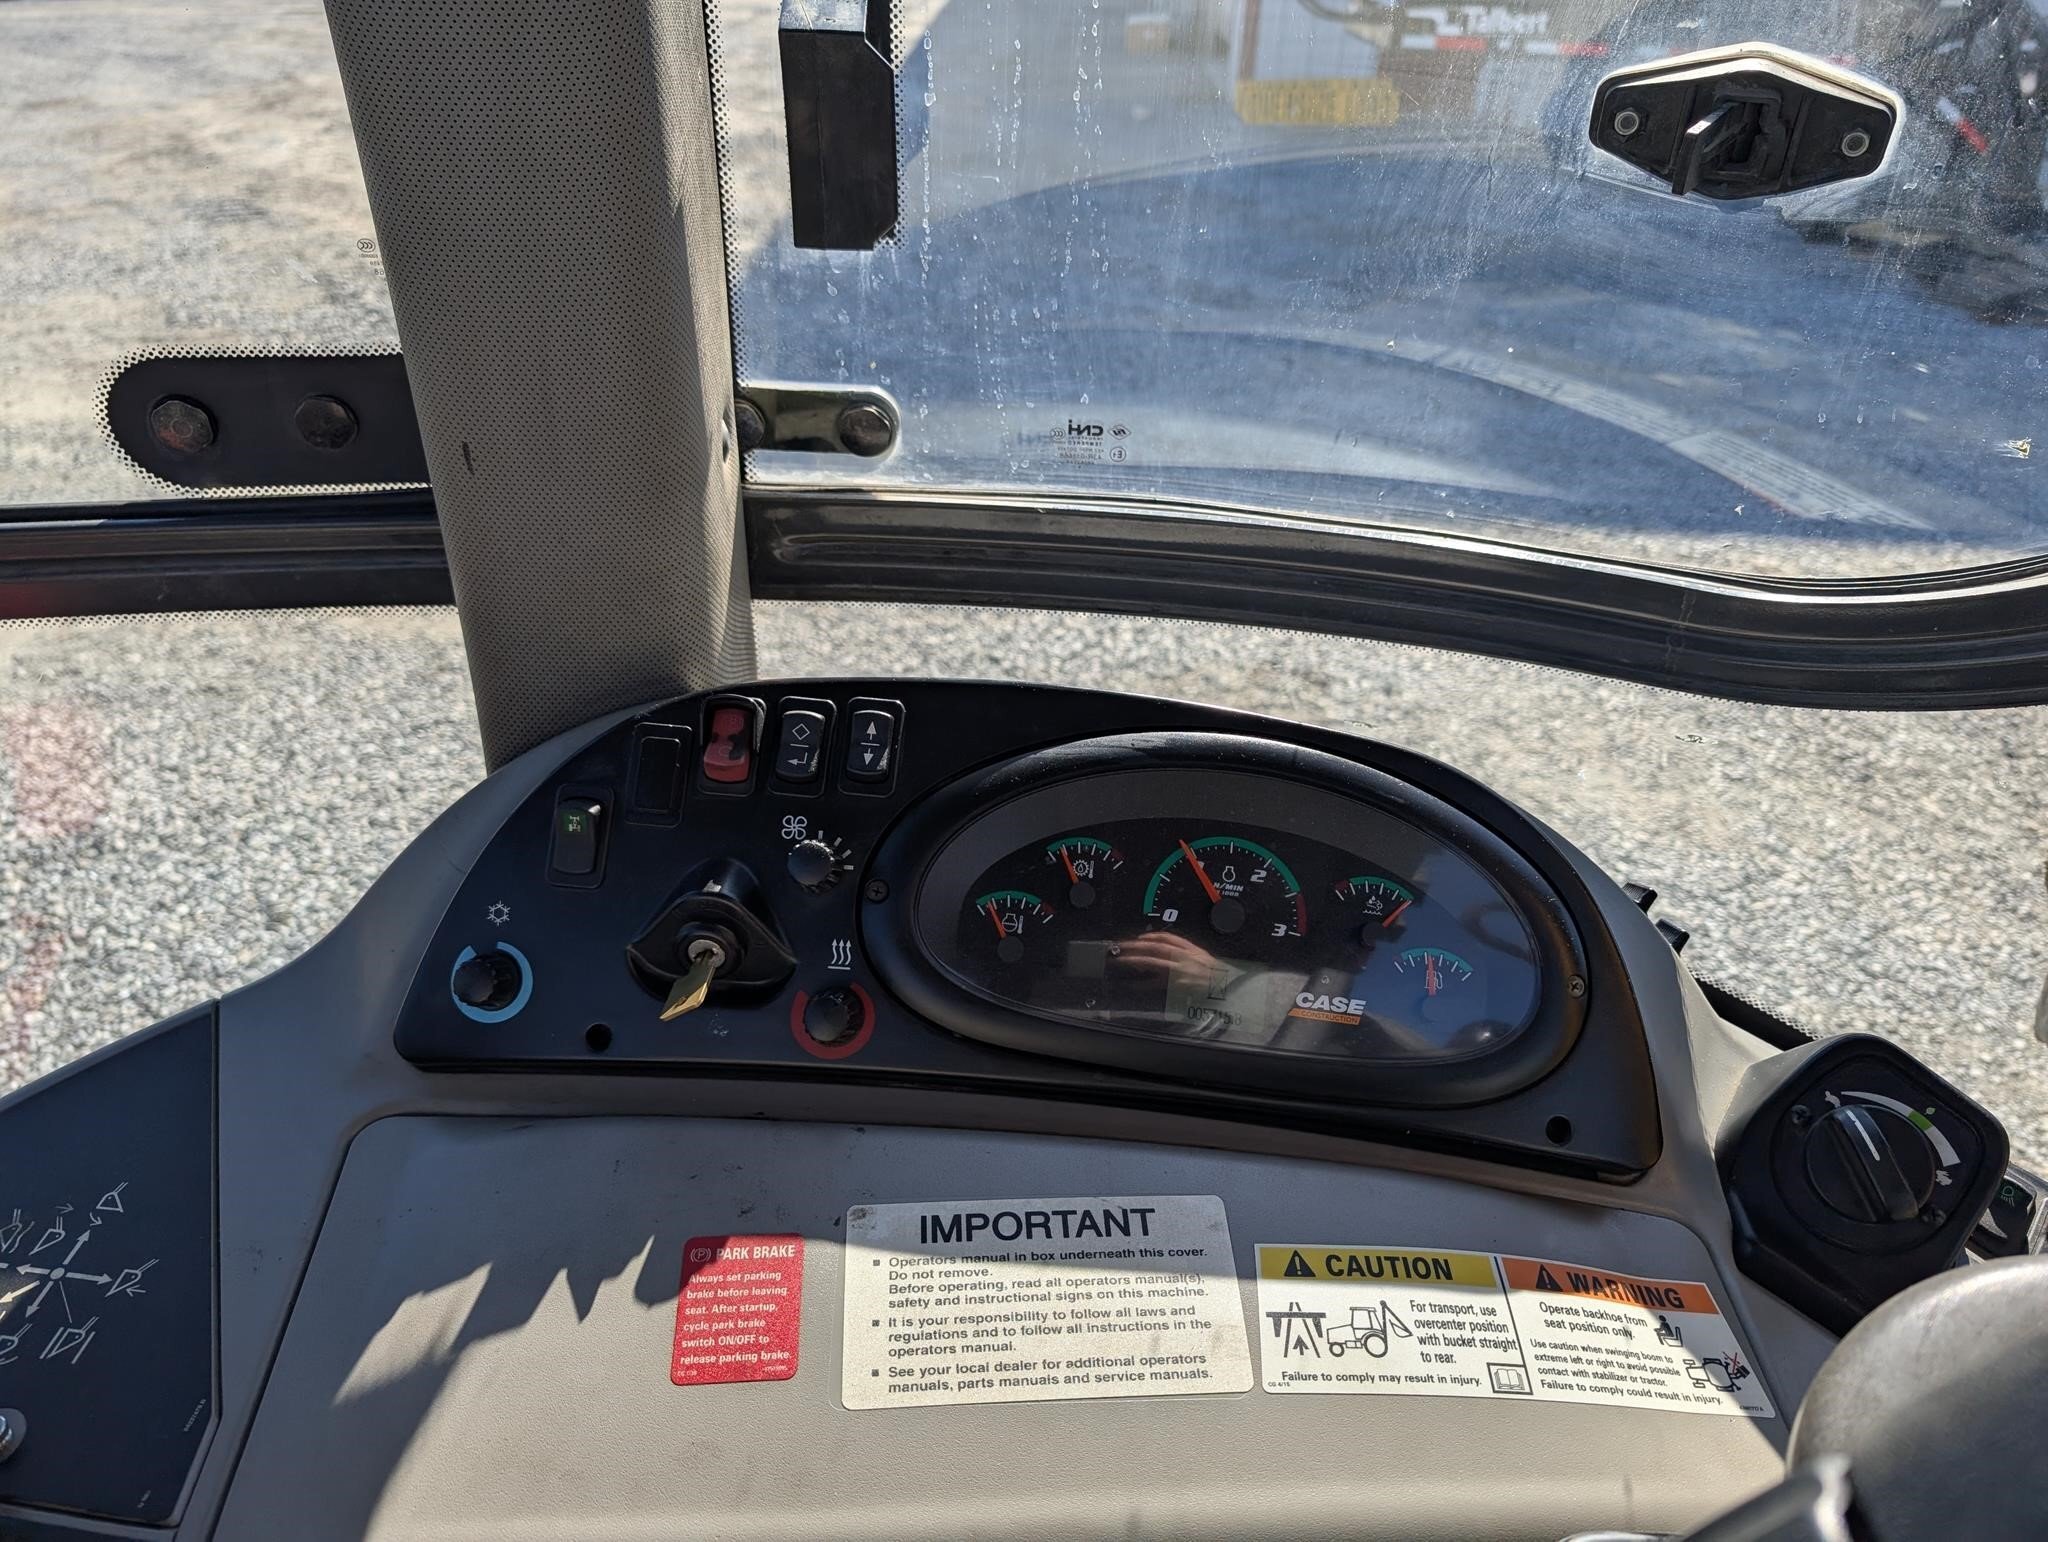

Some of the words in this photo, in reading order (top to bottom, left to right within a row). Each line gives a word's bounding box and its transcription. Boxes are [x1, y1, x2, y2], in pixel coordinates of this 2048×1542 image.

[1250, 869, 1267, 882] 2
[1162, 909, 1178, 922] 0
[1271, 923, 1287, 936] 3
[1296, 992, 1367, 1015] CASE
[921, 1208, 1155, 1244] IMPORTANT
[716, 1247, 749, 1260] PARK
[753, 1245, 795, 1259] BRAKE
[889, 1256, 956, 1269] Operators
[961, 1253, 1010, 1263] manual
[1015, 1252, 1026, 1261] in
[1031, 1251, 1055, 1261] box
[1060, 1249, 1135, 1260] underneath
[1140, 1248, 1164, 1258] this
[1168, 1249, 1208, 1257] cover.
[889, 1271, 907, 1280] Do
[912, 1270, 934, 1279] not
[938, 1269, 993, 1278] remove.
[1325, 1254, 1453, 1281] CAUTION
[689, 1273, 723, 1283] Always
[726, 1273, 741, 1282] set
[744, 1271, 782, 1282] parking
[889, 1284, 934, 1294] Before
[938, 1281, 1008, 1293] operating,
[1012, 1279, 1041, 1288] read
[1046, 1278, 1061, 1287] all
[1066, 1276, 1131, 1289] operators
[686, 1289, 714, 1299] brake
[717, 1287, 749, 1297] before
[752, 1287, 787, 1297] leaving
[888, 1297, 930, 1309] safety
[935, 1296, 960, 1306] and
[965, 1292, 1050, 1304] instructional
[1056, 1290, 1092, 1303] signs
[1097, 1291, 1114, 1299] on
[1119, 1289, 1143, 1298] this
[1148, 1287, 1208, 1297] machine.
[1566, 1272, 1684, 1308] WARNING
[685, 1306, 709, 1315] seat.
[711, 1304, 737, 1314] After
[888, 1318, 897, 1327] It
[902, 1317, 913, 1327] is
[919, 1317, 949, 1328] your
[954, 1311, 1048, 1325] responsibility
[1053, 1311, 1066, 1320] to
[1070, 1309, 1111, 1319] follow
[1116, 1307, 1131, 1317] all
[1136, 1306, 1166, 1316] laws
[1170, 1305, 1195, 1316] and
[1410, 1300, 1426, 1312] For
[1429, 1302, 1478, 1317] transport,
[1480, 1306, 1497, 1316] use
[1539, 1301, 1580, 1316] Operate
[1581, 1307, 1623, 1323] backhoe
[1625, 1313, 1648, 1327] from
[683, 1321, 709, 1332] cycle
[712, 1321, 735, 1331] park
[737, 1319, 766, 1328] brake
[888, 1330, 968, 1344] regulations
[973, 1327, 998, 1338] and
[1003, 1327, 1016, 1336] to
[1021, 1325, 1062, 1336] follow
[1067, 1324, 1082, 1334] all
[1087, 1321, 1170, 1333] instructions
[1174, 1320, 1186, 1329] in
[1190, 1319, 1212, 1329] the
[1414, 1319, 1466, 1330] overcenter
[1469, 1320, 1509, 1333] position
[1544, 1318, 1566, 1329] seat
[1569, 1320, 1610, 1335] position
[1612, 1326, 1635, 1340] only.
[681, 1338, 715, 1348] switch
[718, 1335, 756, 1345] ON/OFF
[759, 1336, 770, 1344] to
[888, 1344, 956, 1359] operators
[961, 1342, 1016, 1353] manual.
[1417, 1333, 1441, 1346] with
[1442, 1333, 1477, 1348] bucket
[1480, 1336, 1518, 1352] straight
[1530, 1338, 1546, 1348] Use
[1549, 1342, 1579, 1351] caution
[1581, 1345, 1603, 1354] when
[1605, 1347, 1640, 1360] swinging
[1641, 1352, 1663, 1362] boom
[680, 1354, 716, 1364] release
[719, 1352, 757, 1365] parking
[1420, 1351, 1431, 1363] to
[1434, 1353, 1456, 1363] rear.
[1534, 1353, 1568, 1363] extreme
[1569, 1355, 1583, 1365] left
[1596, 1358, 1615, 1369] right
[1616, 1360, 1625, 1369] to
[1627, 1363, 1648, 1372] avoid
[1649, 1366, 1681, 1376] possible
[888, 1367, 914, 1377] See
[920, 1366, 951, 1379] your
[956, 1362, 989, 1373] local
[994, 1361, 1037, 1372] dealer
[1042, 1359, 1061, 1370] for
[1066, 1356, 1135, 1369] additional
[1140, 1354, 1206, 1368] operators
[888, 1380, 953, 1393] manuals,
[958, 1378, 994, 1392] parts
[999, 1374, 1059, 1387] manuals
[1064, 1373, 1090, 1384] and
[1095, 1371, 1145, 1383] service
[1150, 1368, 1213, 1380] manuals.
[1282, 1371, 1319, 1382] Failure
[1321, 1372, 1332, 1382] to
[1336, 1372, 1375, 1387] comply
[1379, 1375, 1401, 1386] may
[1404, 1374, 1434, 1383] result
[1437, 1374, 1447, 1383] in
[1450, 1375, 1482, 1387] injury.
[1538, 1367, 1569, 1376] contact
[1571, 1369, 1590, 1378] with
[1591, 1371, 1627, 1382] stabilizer
[1630, 1375, 1638, 1383] or
[1640, 1376, 1668, 1386] tractor.
[1541, 1379, 1574, 1390] Failure
[1576, 1383, 1587, 1392] to
[1589, 1385, 1623, 1396] comply
[1627, 1389, 1652, 1398] could
[1655, 1391, 1680, 1400] result
[1683, 1393, 1692, 1402] in
[1693, 1393, 1723, 1405] injury.
